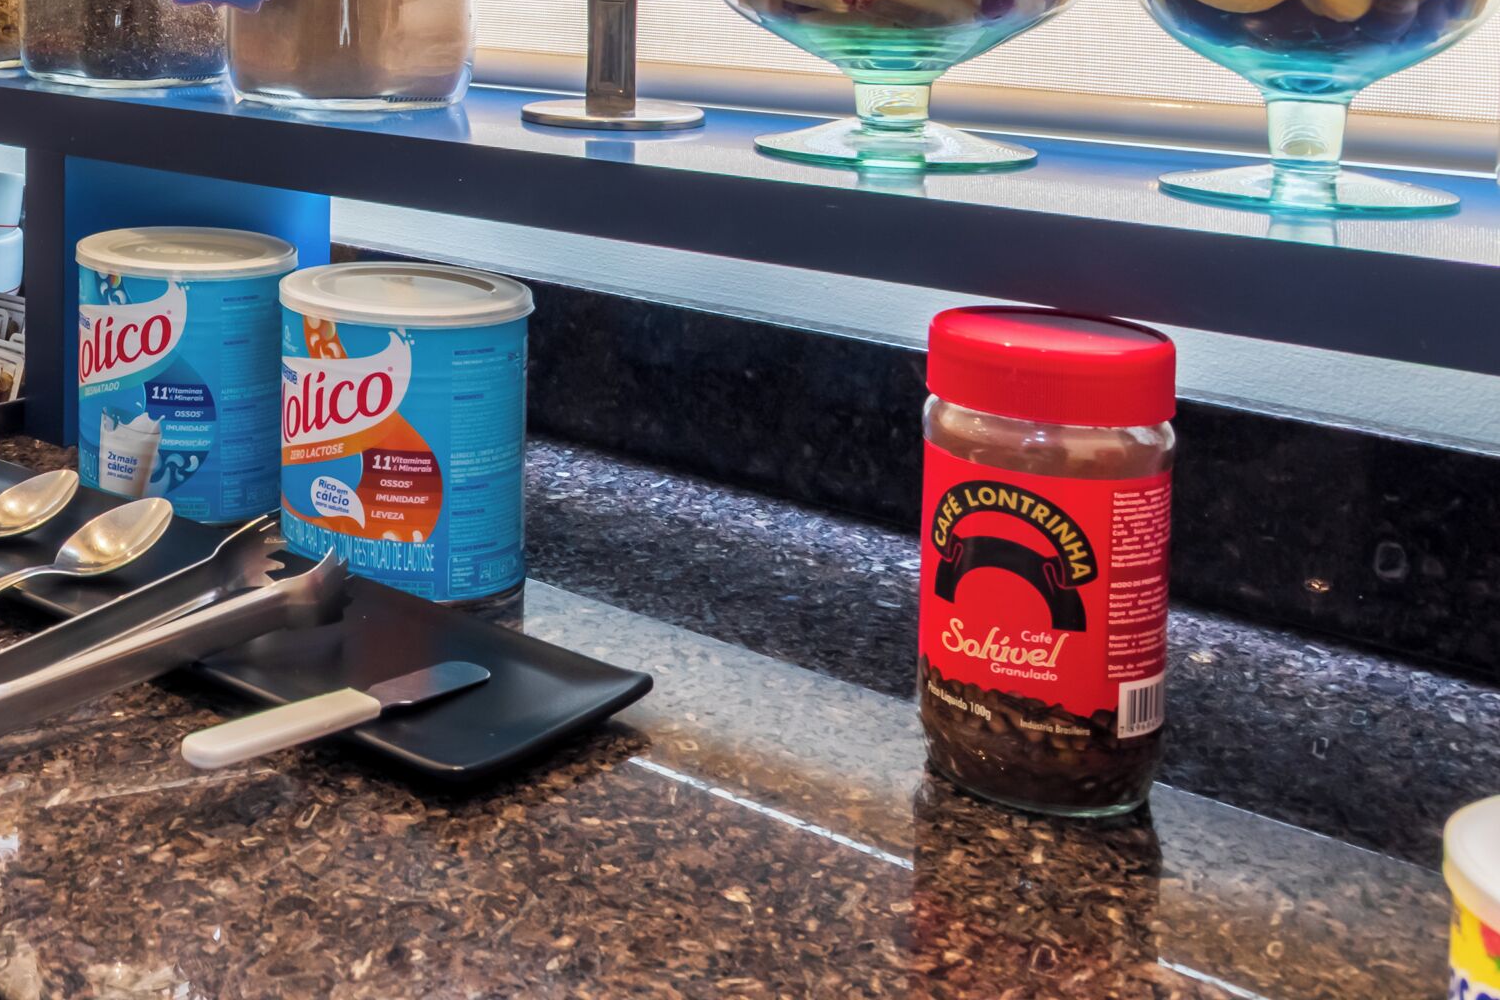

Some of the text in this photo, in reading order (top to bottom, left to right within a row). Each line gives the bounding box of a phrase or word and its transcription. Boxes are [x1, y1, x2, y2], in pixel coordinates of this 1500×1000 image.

[80, 314, 172, 383] olico
[151, 386, 203, 400] 11 Vitaminas
[174, 394, 204, 402] Minerais
[282, 371, 393, 443] olico
[107, 451, 138, 466] 2x mais
[305, 443, 344, 459] LACTOSE
[372, 454, 431, 470] 11 Vitaminas
[398, 464, 432, 473] Minerais
[318, 479, 336, 491] Rico
[315, 489, 350, 507] cálcio
[371, 510, 405, 521] LEVEZA
[934, 492, 963, 547] CAFÉ
[964, 487, 1092, 580] LONTRINHA
[393, 542, 402, 571] DE
[403, 543, 435, 572] LACTOSE
[941, 617, 1070, 668] Solúvel
[1020, 630, 1053, 645] Café
[990, 662, 1059, 682] Granulado
[940, 687, 968, 712] Líquido
[969, 701, 992, 721] 100g
[1055, 723, 1091, 737] Brasileira
